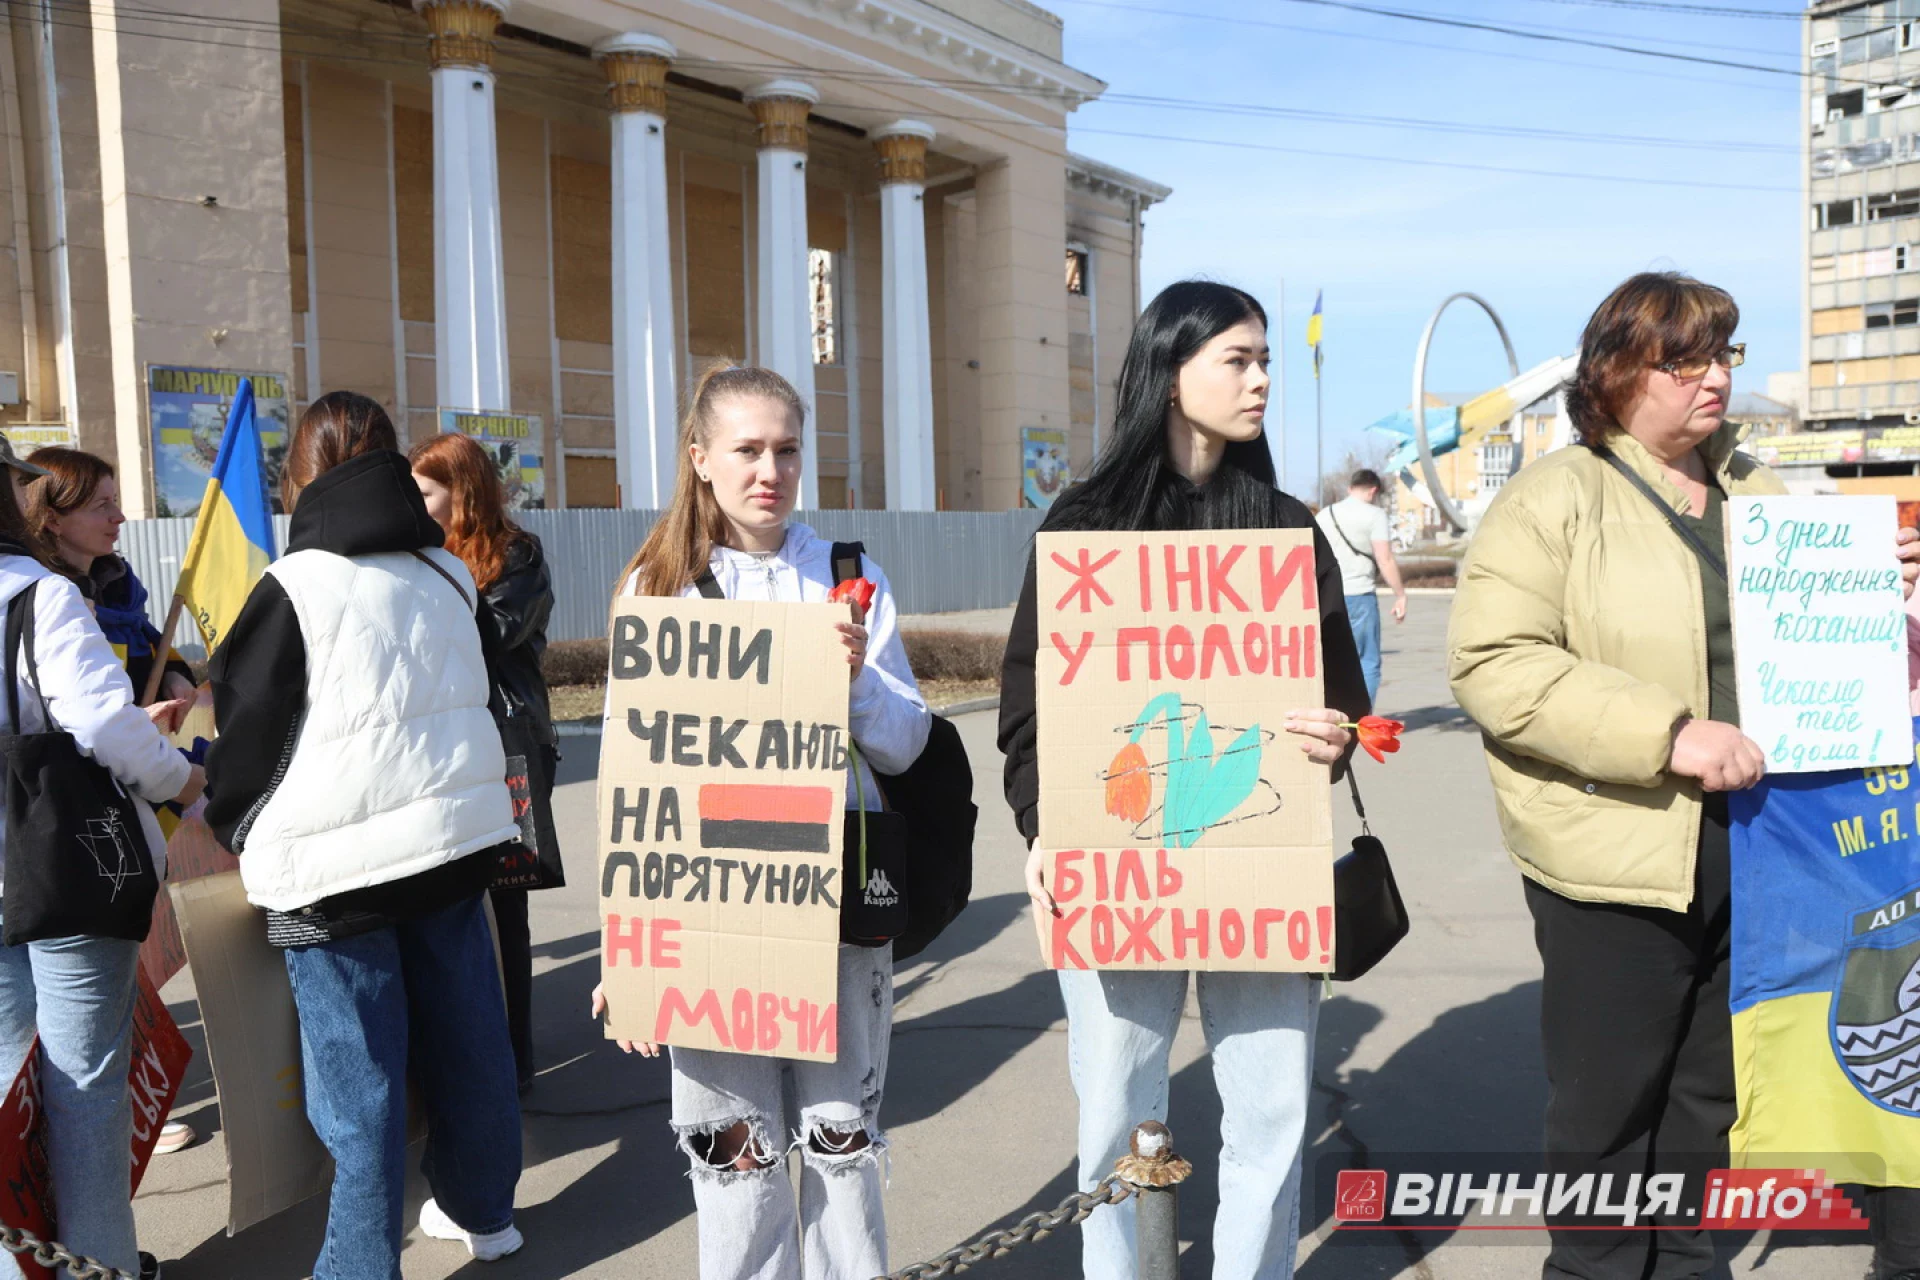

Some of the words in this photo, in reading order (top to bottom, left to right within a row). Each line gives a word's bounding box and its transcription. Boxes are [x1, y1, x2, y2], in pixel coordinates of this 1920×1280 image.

[151, 368, 284, 398] МАРІУПЛЬ
[456, 415, 529, 438] ЧЕРНІГІВ
[1743, 503, 1769, 545] З
[1775, 519, 1852, 566] днем
[1051, 544, 1317, 614] ЖІНКИ
[1739, 565, 1902, 611] народження,
[612, 615, 773, 685] ВОНИ
[1050, 631, 1095, 686] У
[1116, 622, 1316, 681] ПОЛОНІ
[1757, 660, 1864, 706] Чекаємо
[628, 707, 848, 771] ЧЕКАЮТЬ
[1796, 704, 1862, 733] тебе
[611, 786, 682, 844] НА
[1880, 807, 1908, 844] Я.
[602, 851, 840, 909] ПОРЯТУНОК
[1052, 849, 1183, 903] БІЛЬ
[606, 914, 682, 968] НЕ
[1052, 904, 1333, 970] КОЖНОГО!
[1869, 900, 1905, 930] ДО
[655, 986, 838, 1054] МОВЧИ
